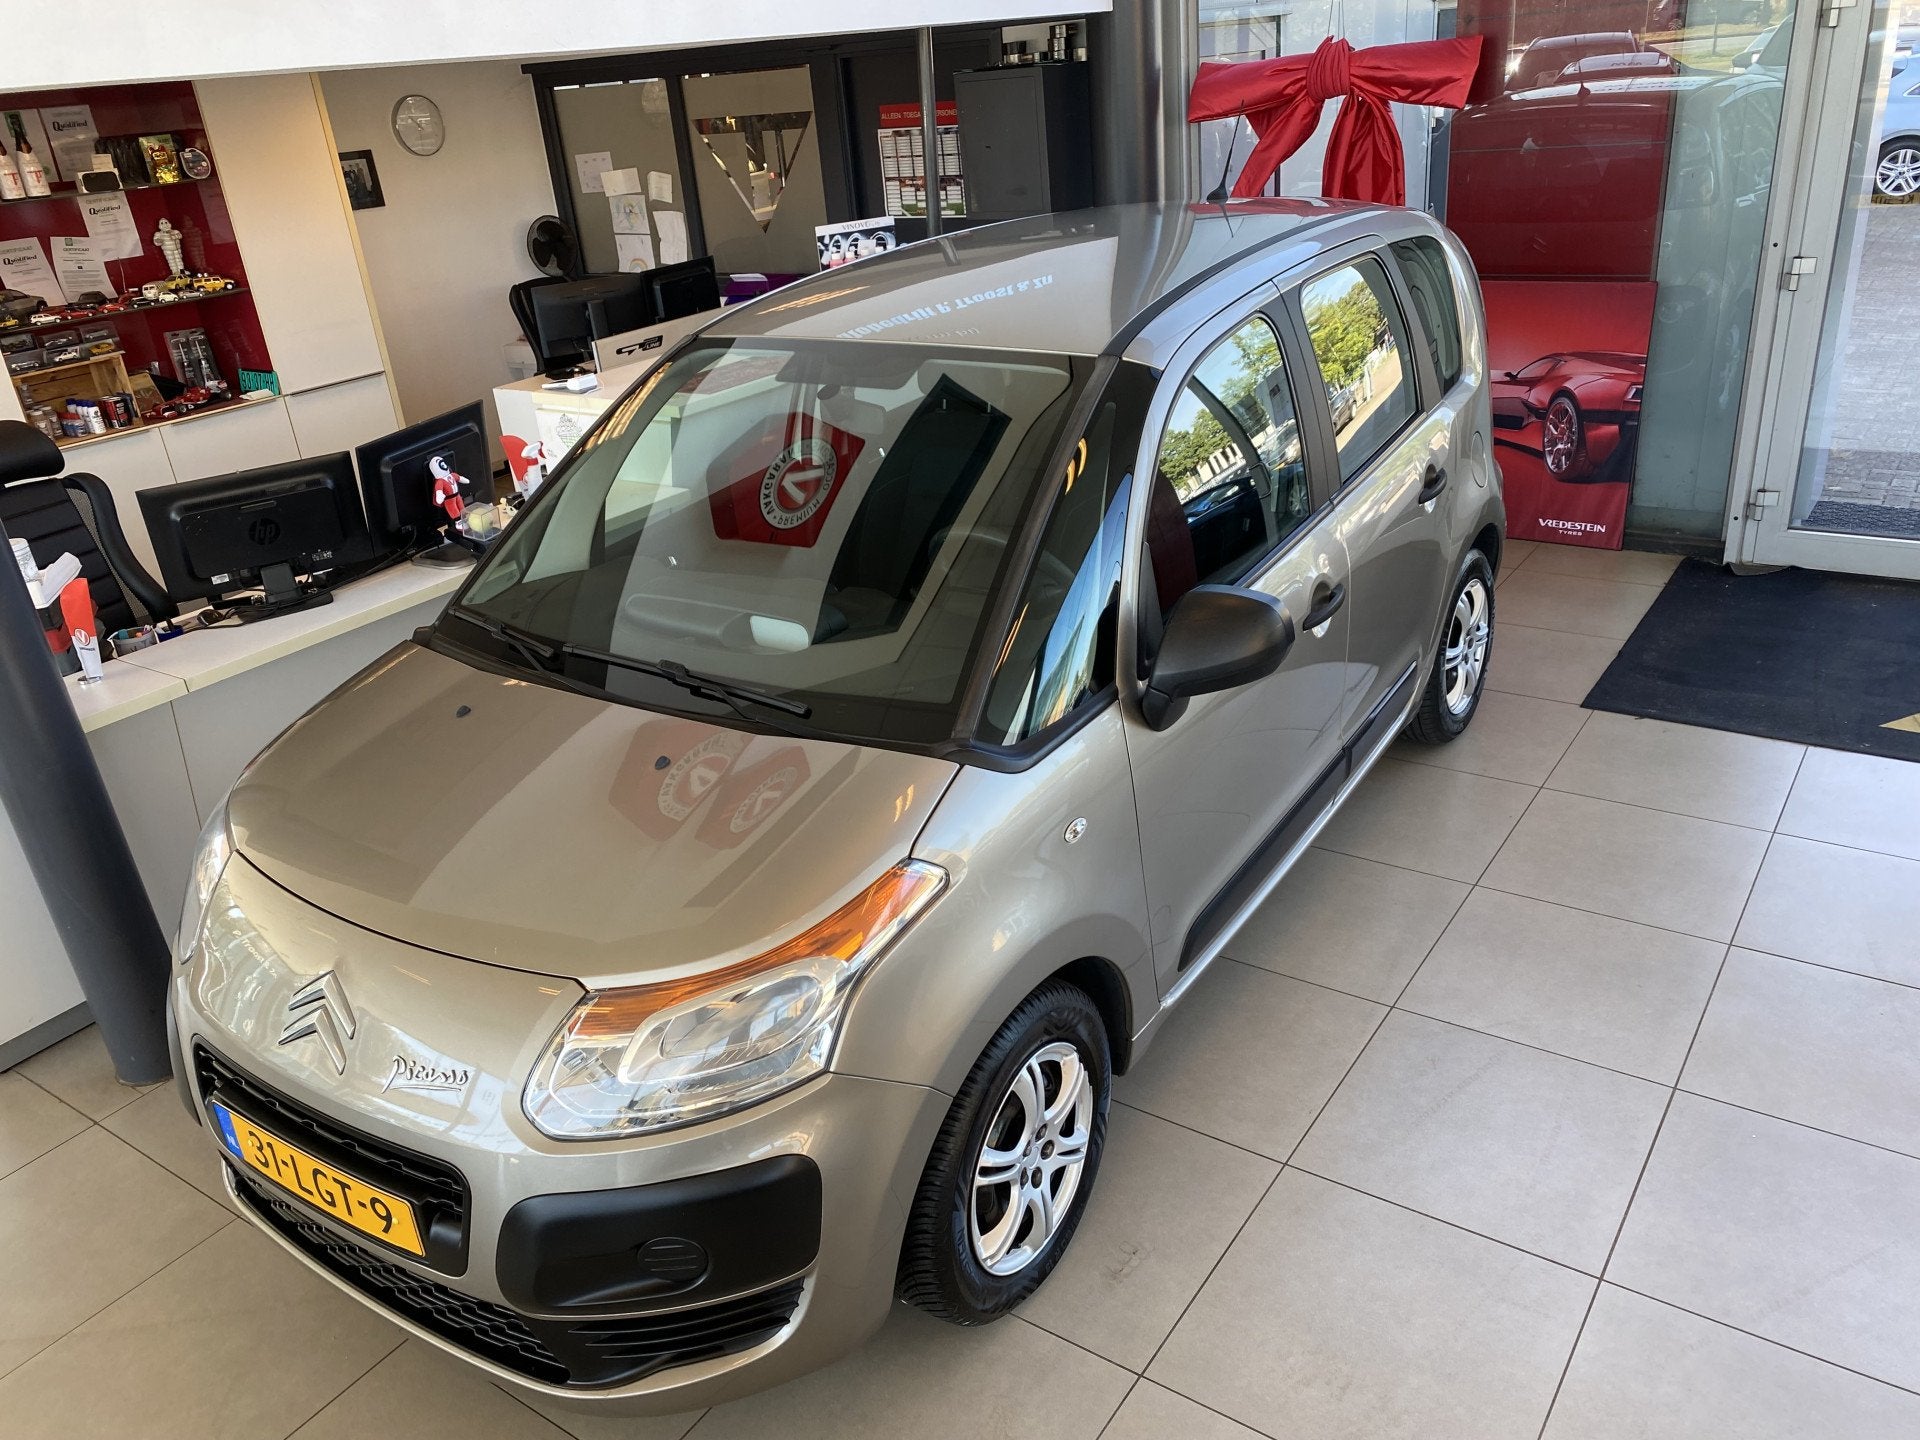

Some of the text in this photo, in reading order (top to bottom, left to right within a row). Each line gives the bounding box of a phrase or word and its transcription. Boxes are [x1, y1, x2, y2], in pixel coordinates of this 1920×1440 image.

[881, 112, 901, 120] ALLEEN
[1538, 518, 1606, 533] VREDESTEIN
[381, 1055, 469, 1094] Picasso
[248, 1130, 393, 1234] 31-LGT-9
